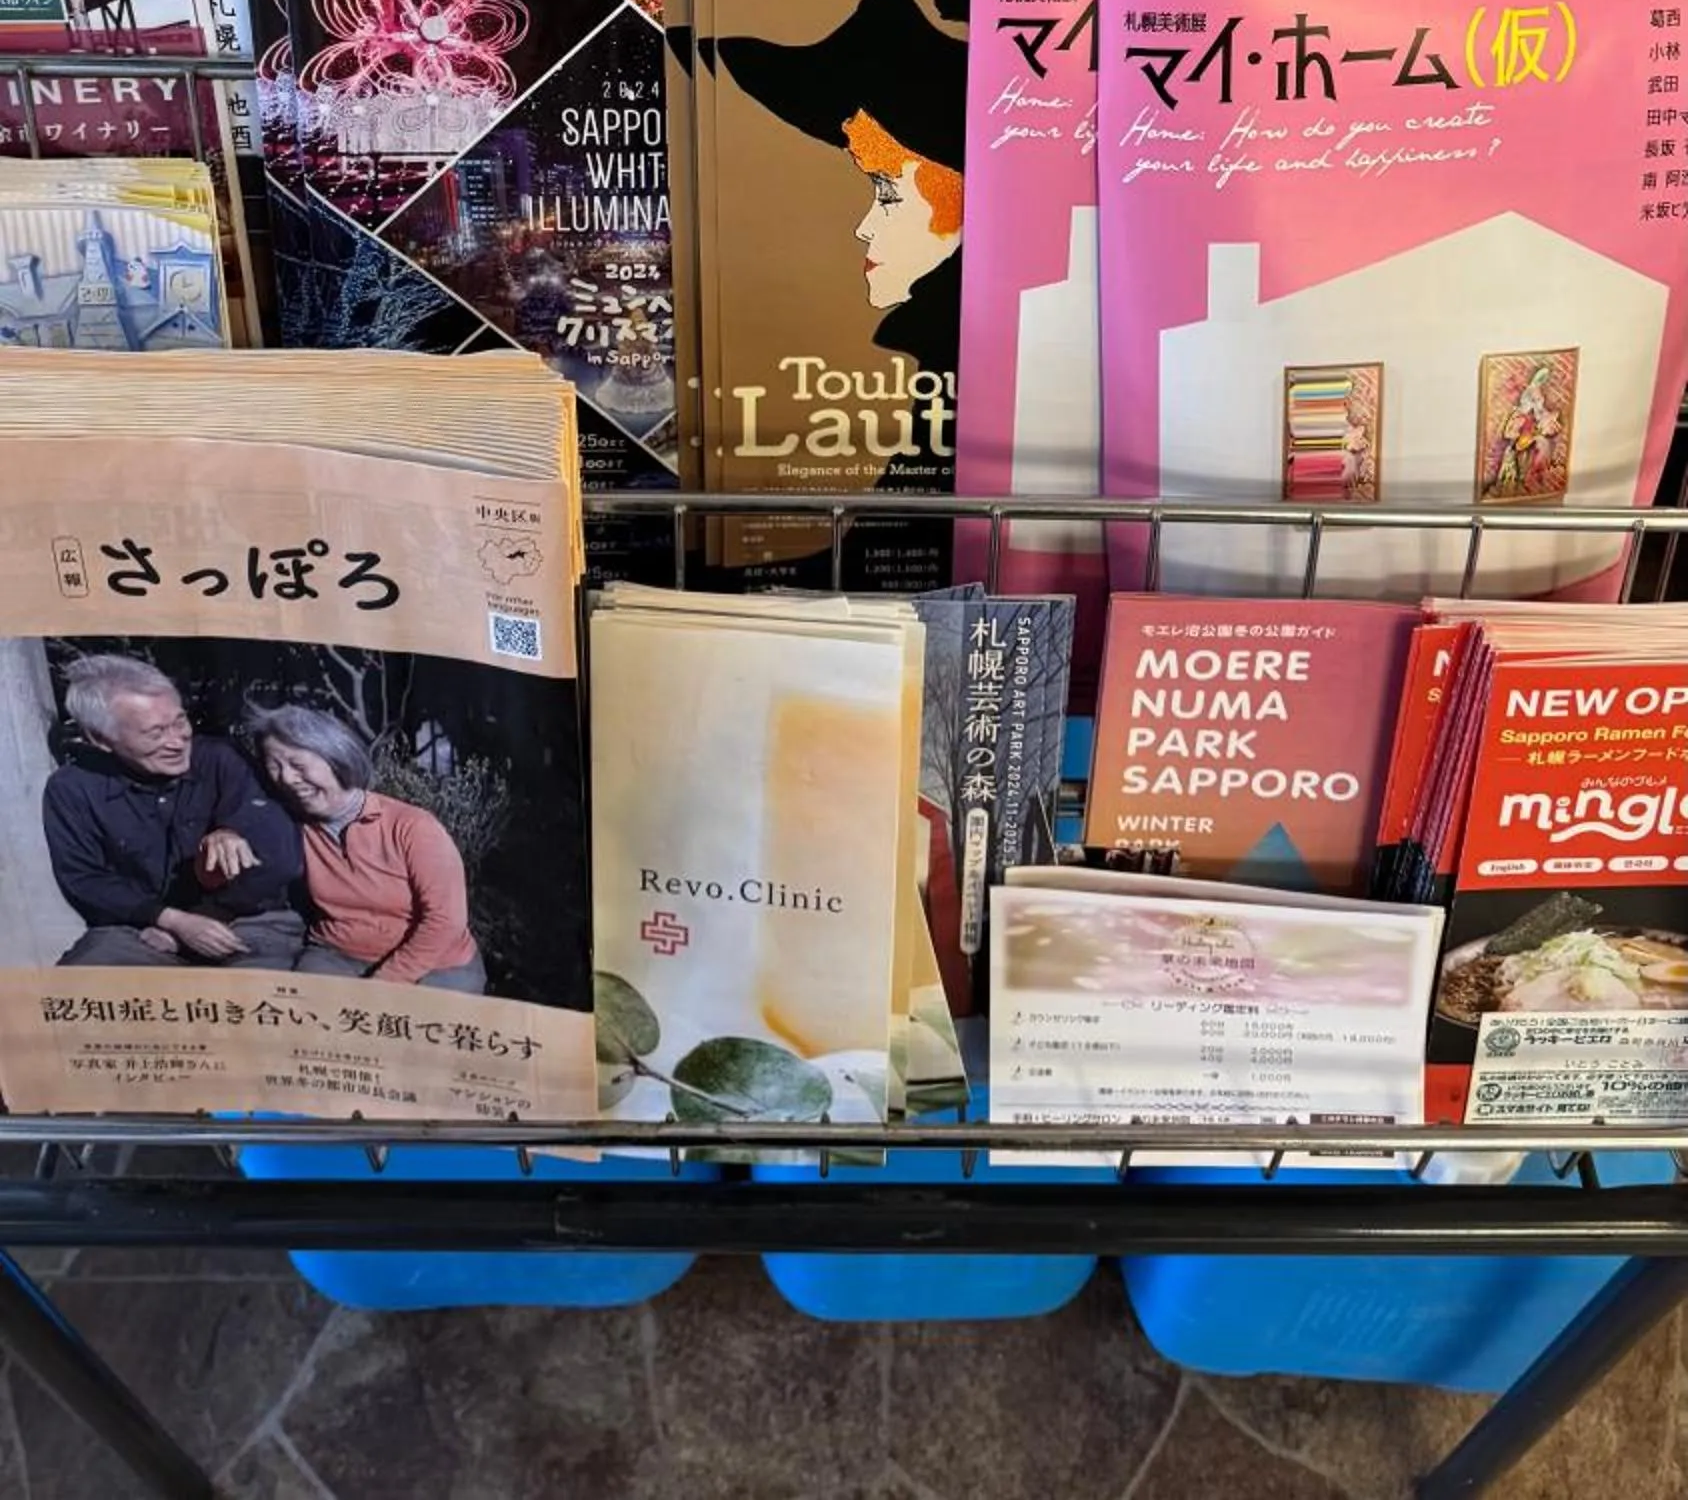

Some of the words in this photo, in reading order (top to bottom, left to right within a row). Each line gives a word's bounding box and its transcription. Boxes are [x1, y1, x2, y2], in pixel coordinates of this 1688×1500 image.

[1123, 11, 1208, 33] 札幌美術展
[1649, 41, 1681, 62] 小林
[1647, 75, 1679, 95] 武田
[561, 107, 668, 148] SAPPO
[989, 123, 1063, 150] your
[1218, 103, 1290, 152] How
[1302, 116, 1336, 140] do
[1335, 120, 1393, 152] you
[1404, 101, 1496, 132] create
[585, 151, 669, 190] WHIT
[1122, 155, 1196, 184] your
[1207, 154, 1265, 189] life
[1274, 149, 1335, 171] and
[587, 352, 602, 364] in
[605, 350, 673, 368] Sappor
[777, 463, 841, 479] Elegance
[844, 463, 860, 477] of
[862, 463, 886, 477] the
[889, 463, 938, 477] Master
[60, 548, 84, 590] 広報
[100, 536, 401, 611] さっぽろ
[1140, 623, 1337, 640] モエレ沼公園冬の公園ガイド
[1011, 616, 1032, 687] SAPPORO
[1135, 648, 1312, 682] MOERE
[959, 616, 1007, 803] 札幌芸術の森
[1012, 688, 1027, 718] ART
[1130, 688, 1289, 721] NUMA
[1505, 688, 1620, 718] NEW
[1007, 722, 1025, 760] PARK
[1126, 726, 1258, 760] PARK
[1499, 727, 1588, 747] Sapporo
[1593, 725, 1666, 743] Ramen
[1120, 764, 1360, 802] SAPPORO
[1116, 814, 1215, 834] WINTER
[640, 867, 844, 914] Revo.Clinic
[43, 996, 544, 1061] 認知症と向き合い、笑顔で暮らす
